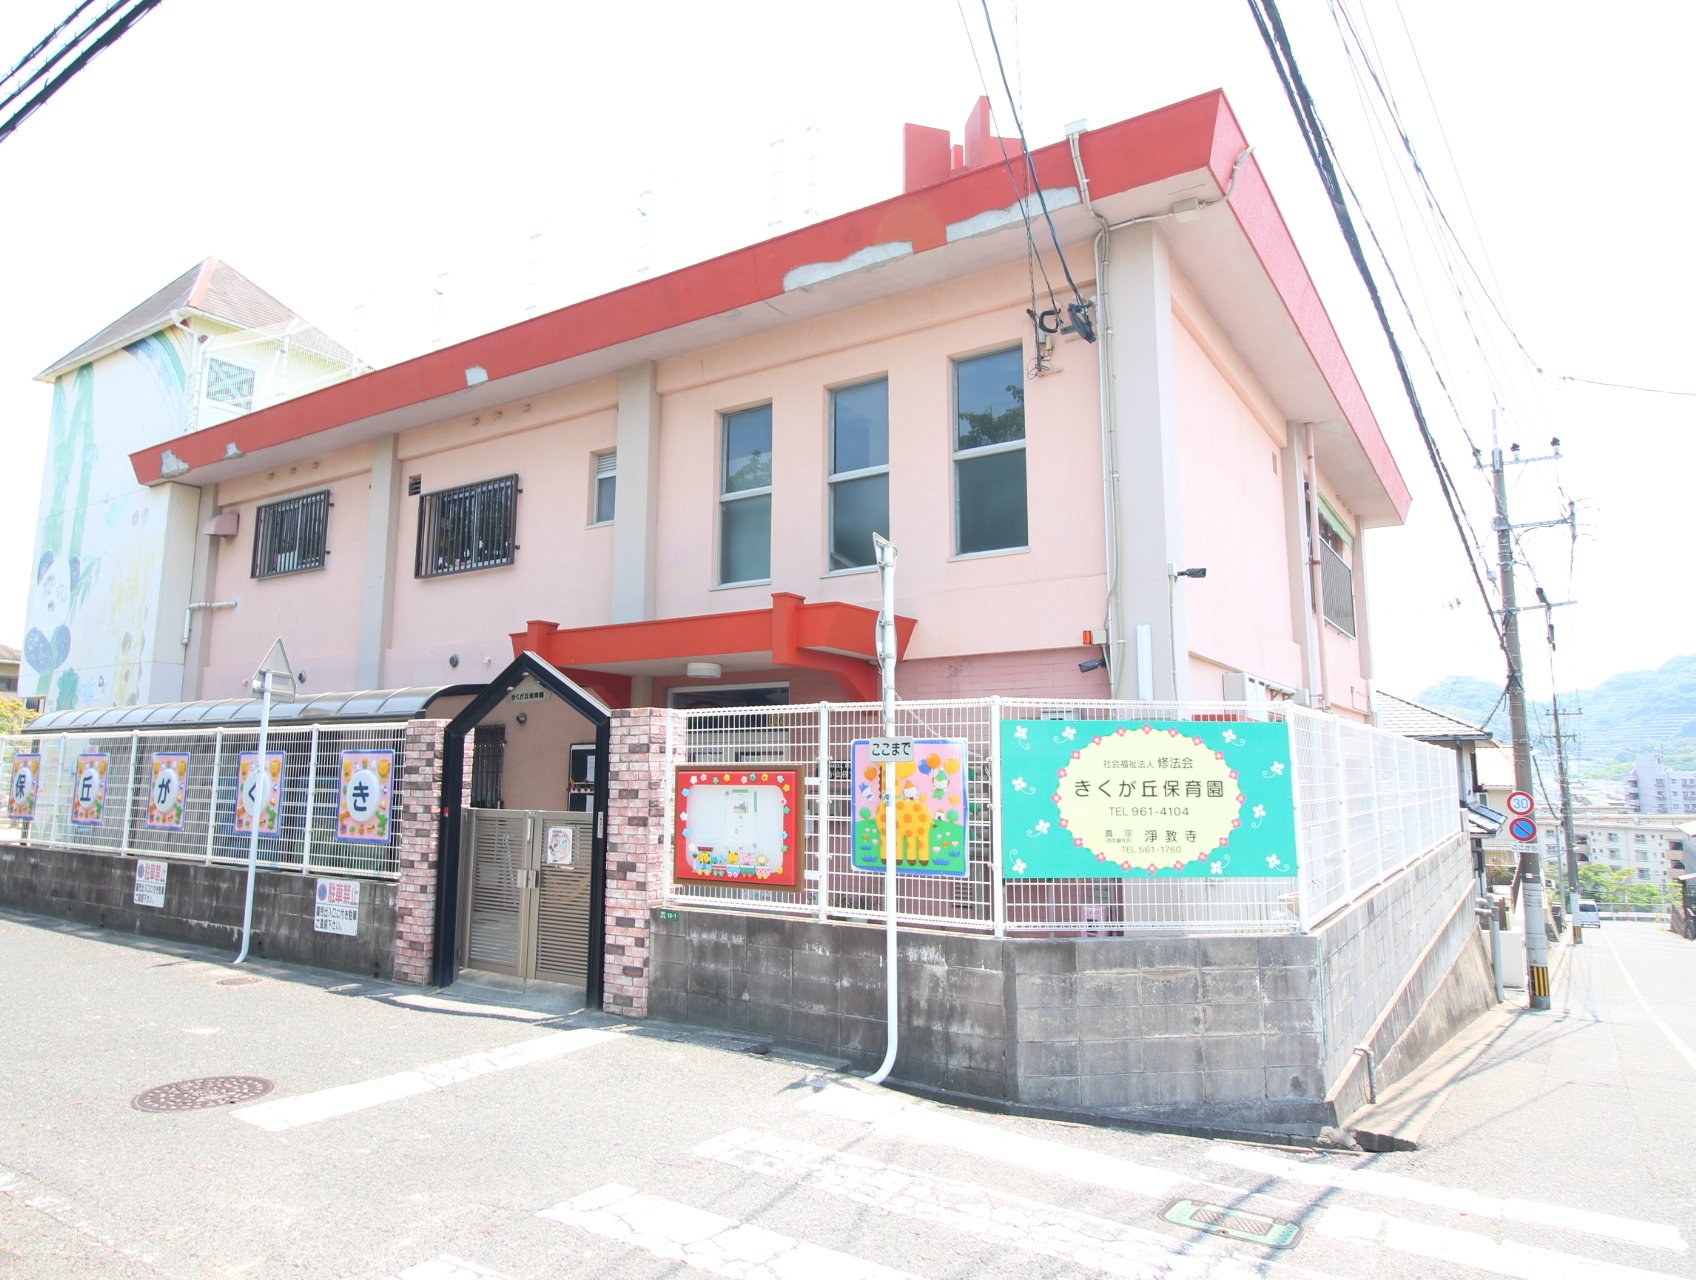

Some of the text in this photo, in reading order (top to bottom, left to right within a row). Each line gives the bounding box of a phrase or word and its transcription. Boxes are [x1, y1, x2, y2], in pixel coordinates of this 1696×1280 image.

[871, 742, 911, 757] ここまで
[1103, 757, 1194, 769] 社会福祉法人 修法会
[15, 775, 26, 798] 保
[80, 775, 92, 802] 丘
[158, 778, 172, 804] が
[1075, 780, 1223, 798] きくが丘保育園
[352, 780, 370, 812] き
[1513, 798, 1529, 809] 30
[1109, 807, 1189, 817] TEL 961-4104
[1121, 846, 1182, 854] TEL 561-1760
[328, 883, 358, 905] 駐車禁止
